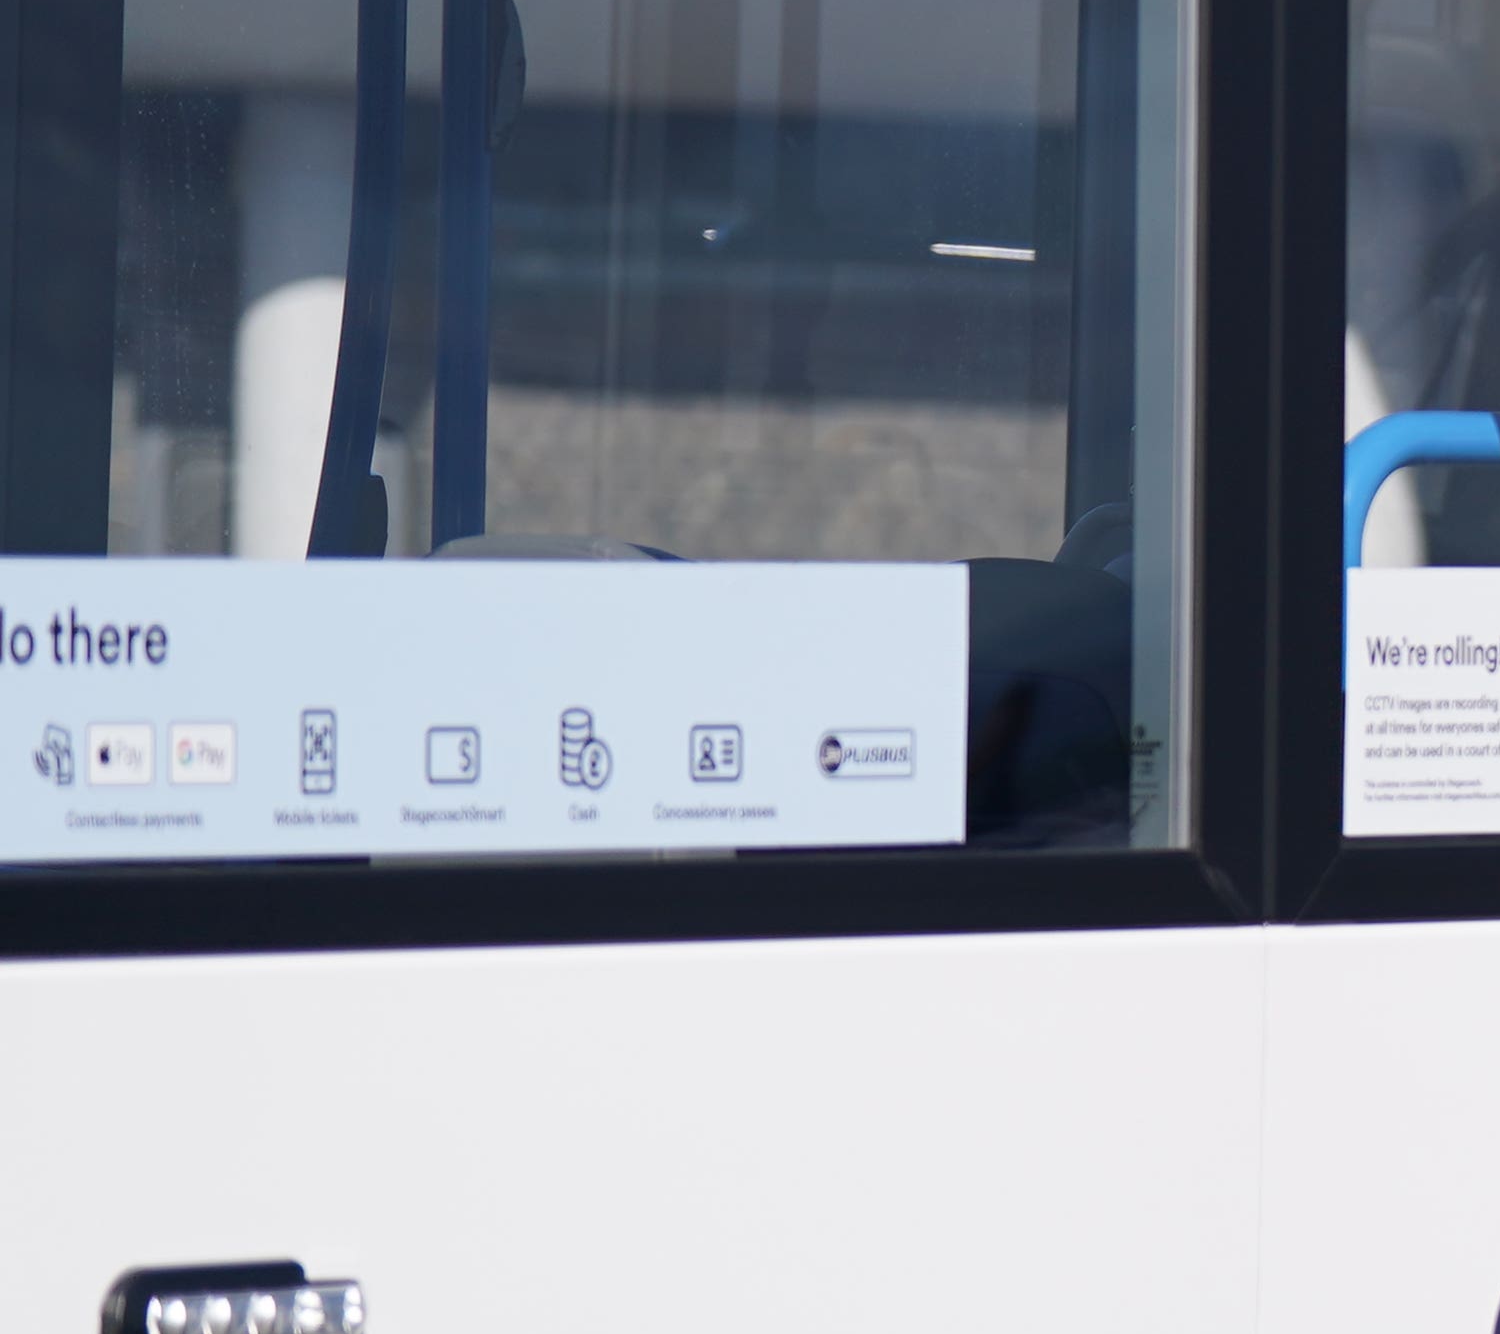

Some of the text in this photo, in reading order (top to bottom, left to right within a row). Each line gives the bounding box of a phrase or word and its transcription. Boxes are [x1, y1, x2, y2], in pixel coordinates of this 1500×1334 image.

[49, 606, 169, 666] there
[1365, 635, 1427, 667] We're
[1364, 694, 1499, 714] CCTV images are recording
[1389, 719, 1417, 735] times
[1419, 718, 1433, 734] for
[1365, 744, 1382, 759] and
[1384, 746, 1402, 758] can
[1418, 743, 1443, 758] used
[1464, 742, 1490, 757] court
